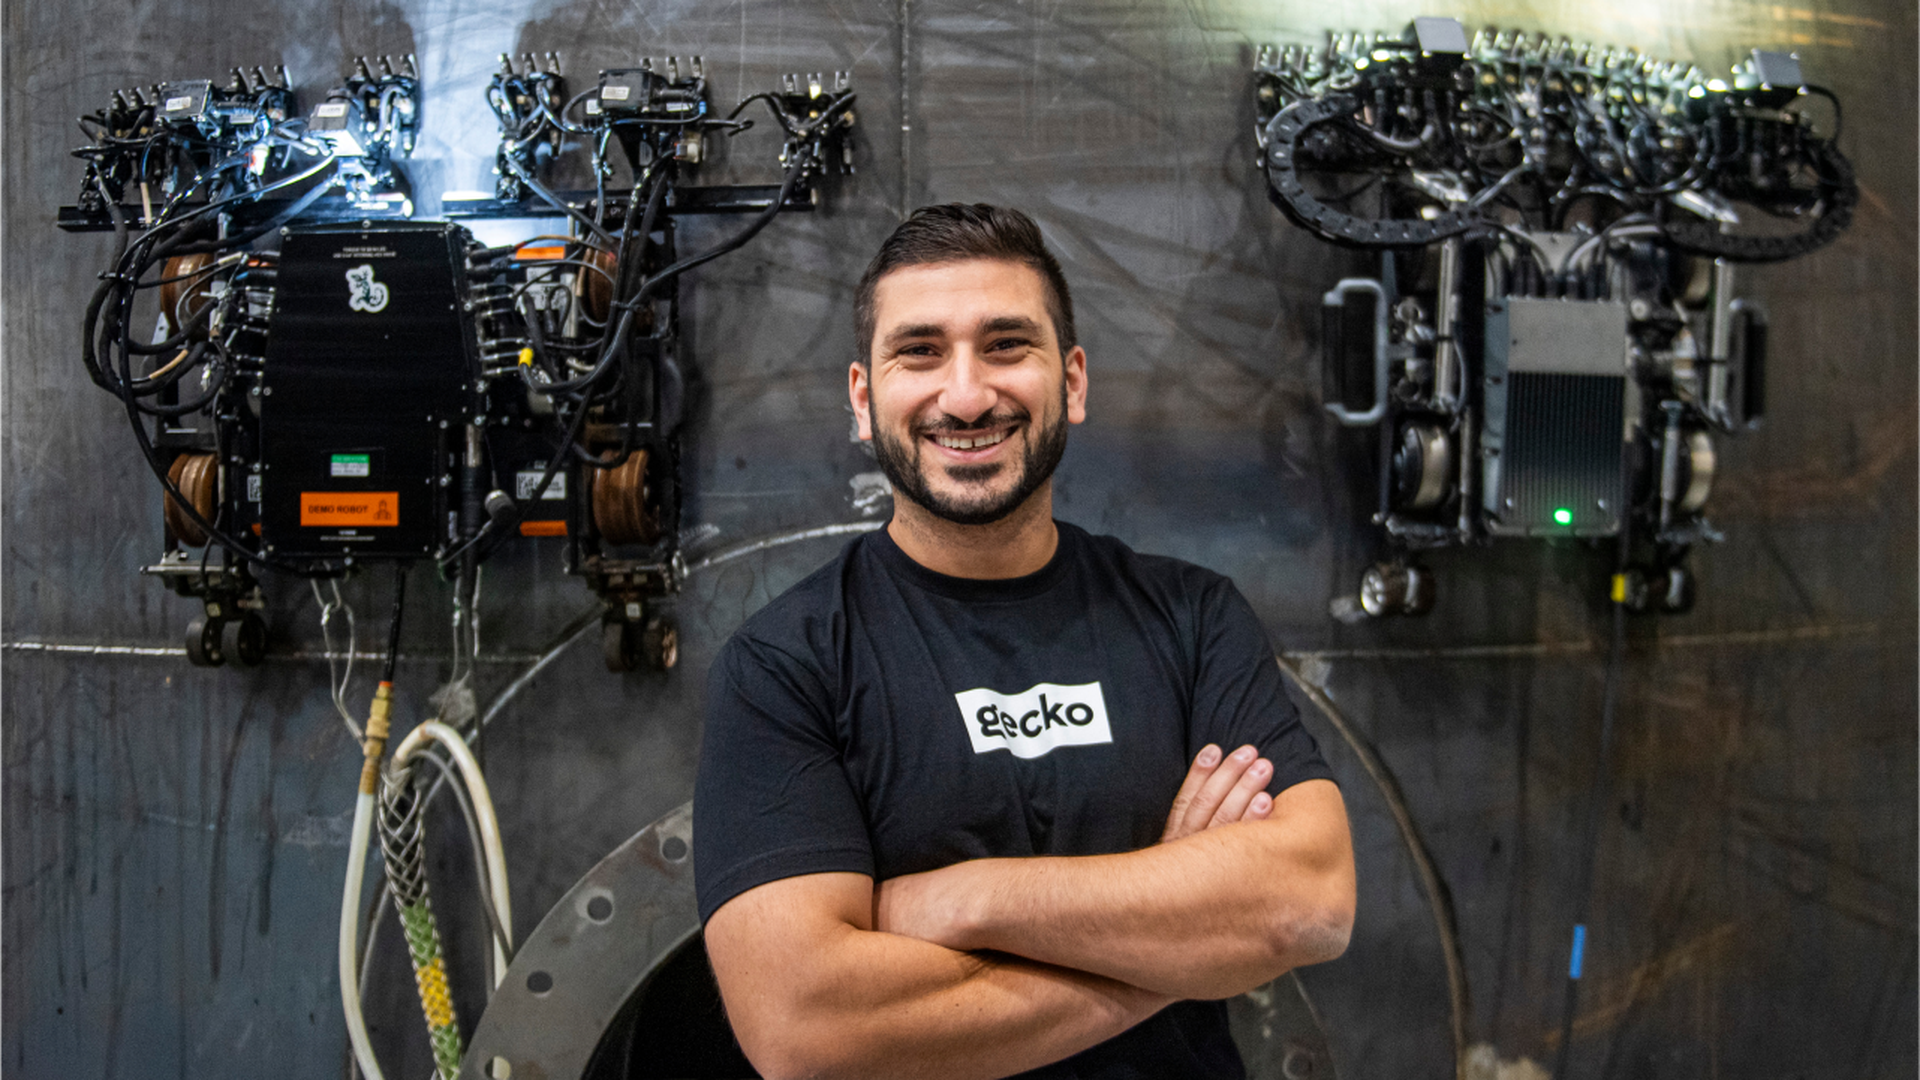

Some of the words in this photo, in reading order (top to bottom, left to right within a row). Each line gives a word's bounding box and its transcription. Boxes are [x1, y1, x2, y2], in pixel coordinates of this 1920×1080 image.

[308, 505, 335, 514] DEMO
[337, 505, 368, 514] ROBOT
[976, 693, 1094, 739] gecko
